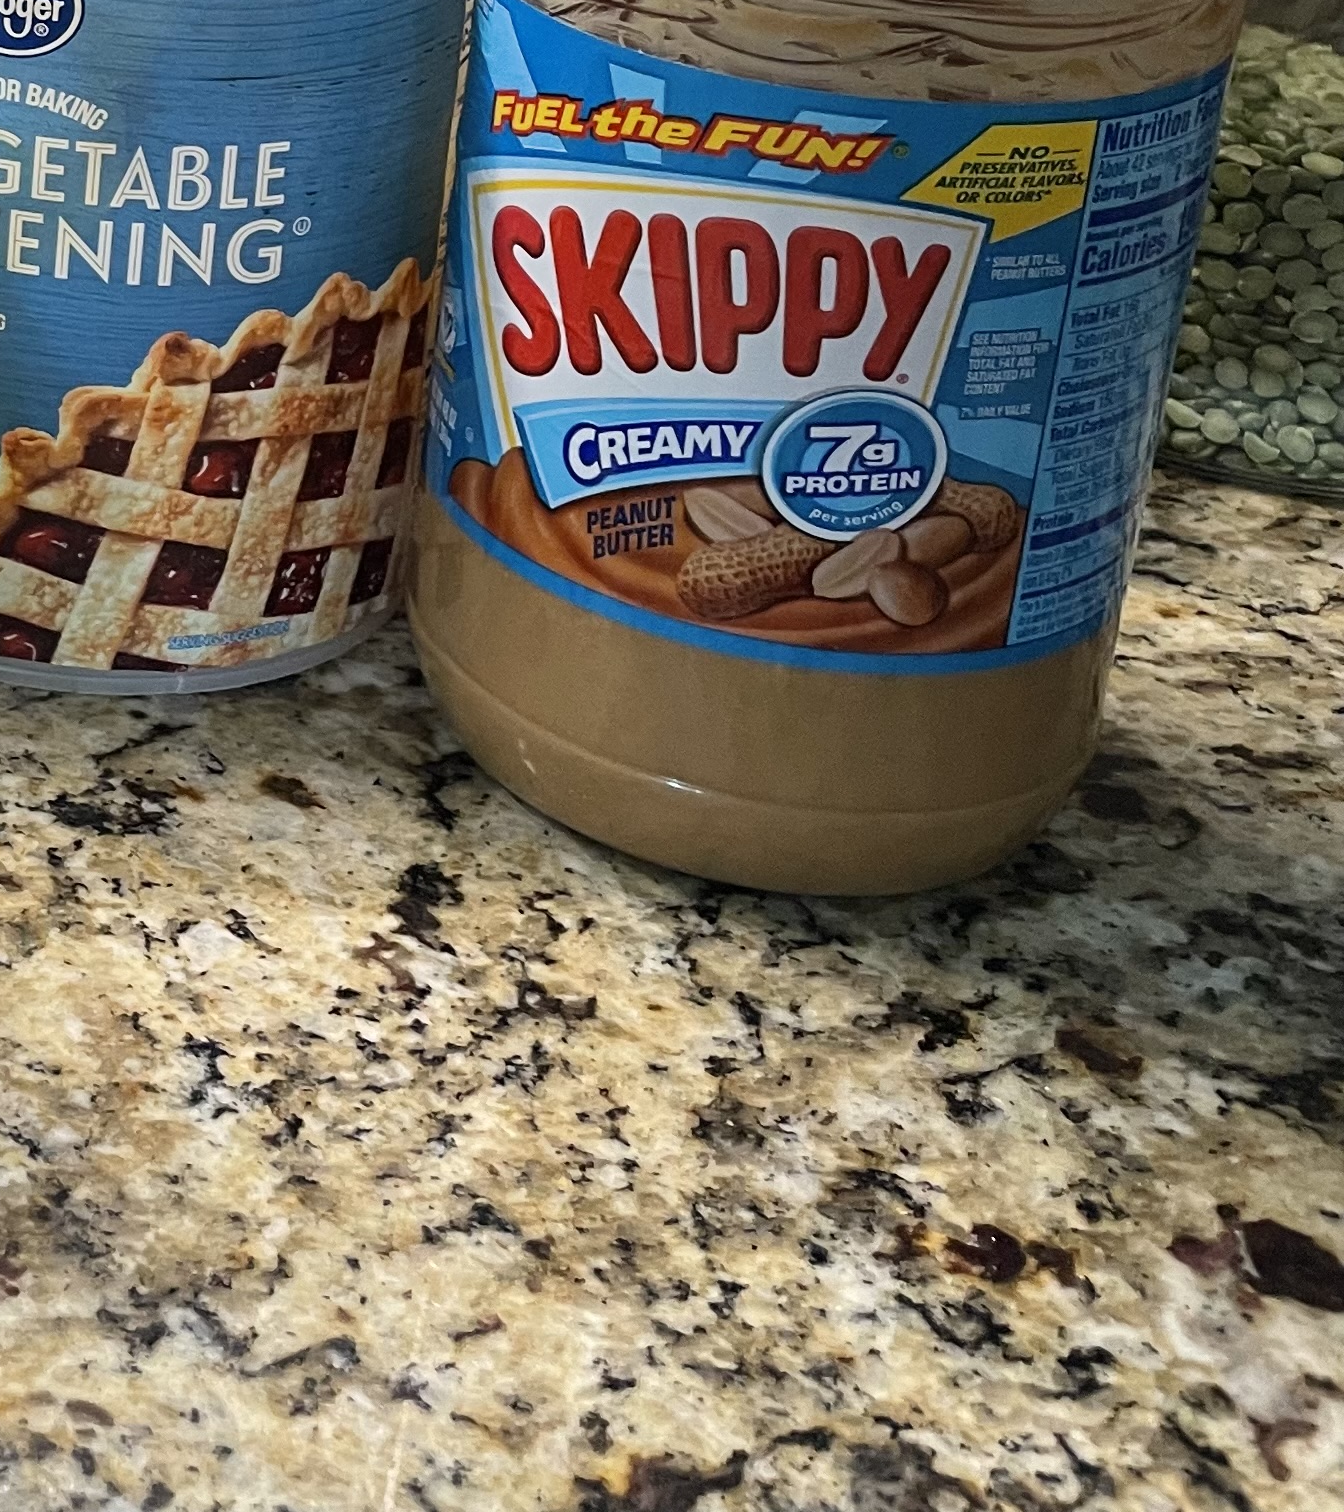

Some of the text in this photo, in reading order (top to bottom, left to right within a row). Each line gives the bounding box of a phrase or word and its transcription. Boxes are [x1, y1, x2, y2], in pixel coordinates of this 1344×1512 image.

[24, 83, 110, 131] BAKING
[493, 94, 889, 171] FUEL the FUN!
[1102, 109, 1190, 153] Nutrition
[1008, 146, 1050, 161] NO
[934, 172, 1088, 189] ARTIFICIAL FLAVORS,
[955, 191, 980, 204] OR
[1080, 232, 1166, 276] Calories
[492, 204, 952, 383] SKIPPY
[568, 423, 756, 481] CREAMY
[809, 425, 896, 474] 7g
[785, 469, 921, 495] PROTEIN
[586, 496, 676, 534] PEANUT
[808, 498, 904, 527] per serving
[592, 522, 674, 560] BUTTER
